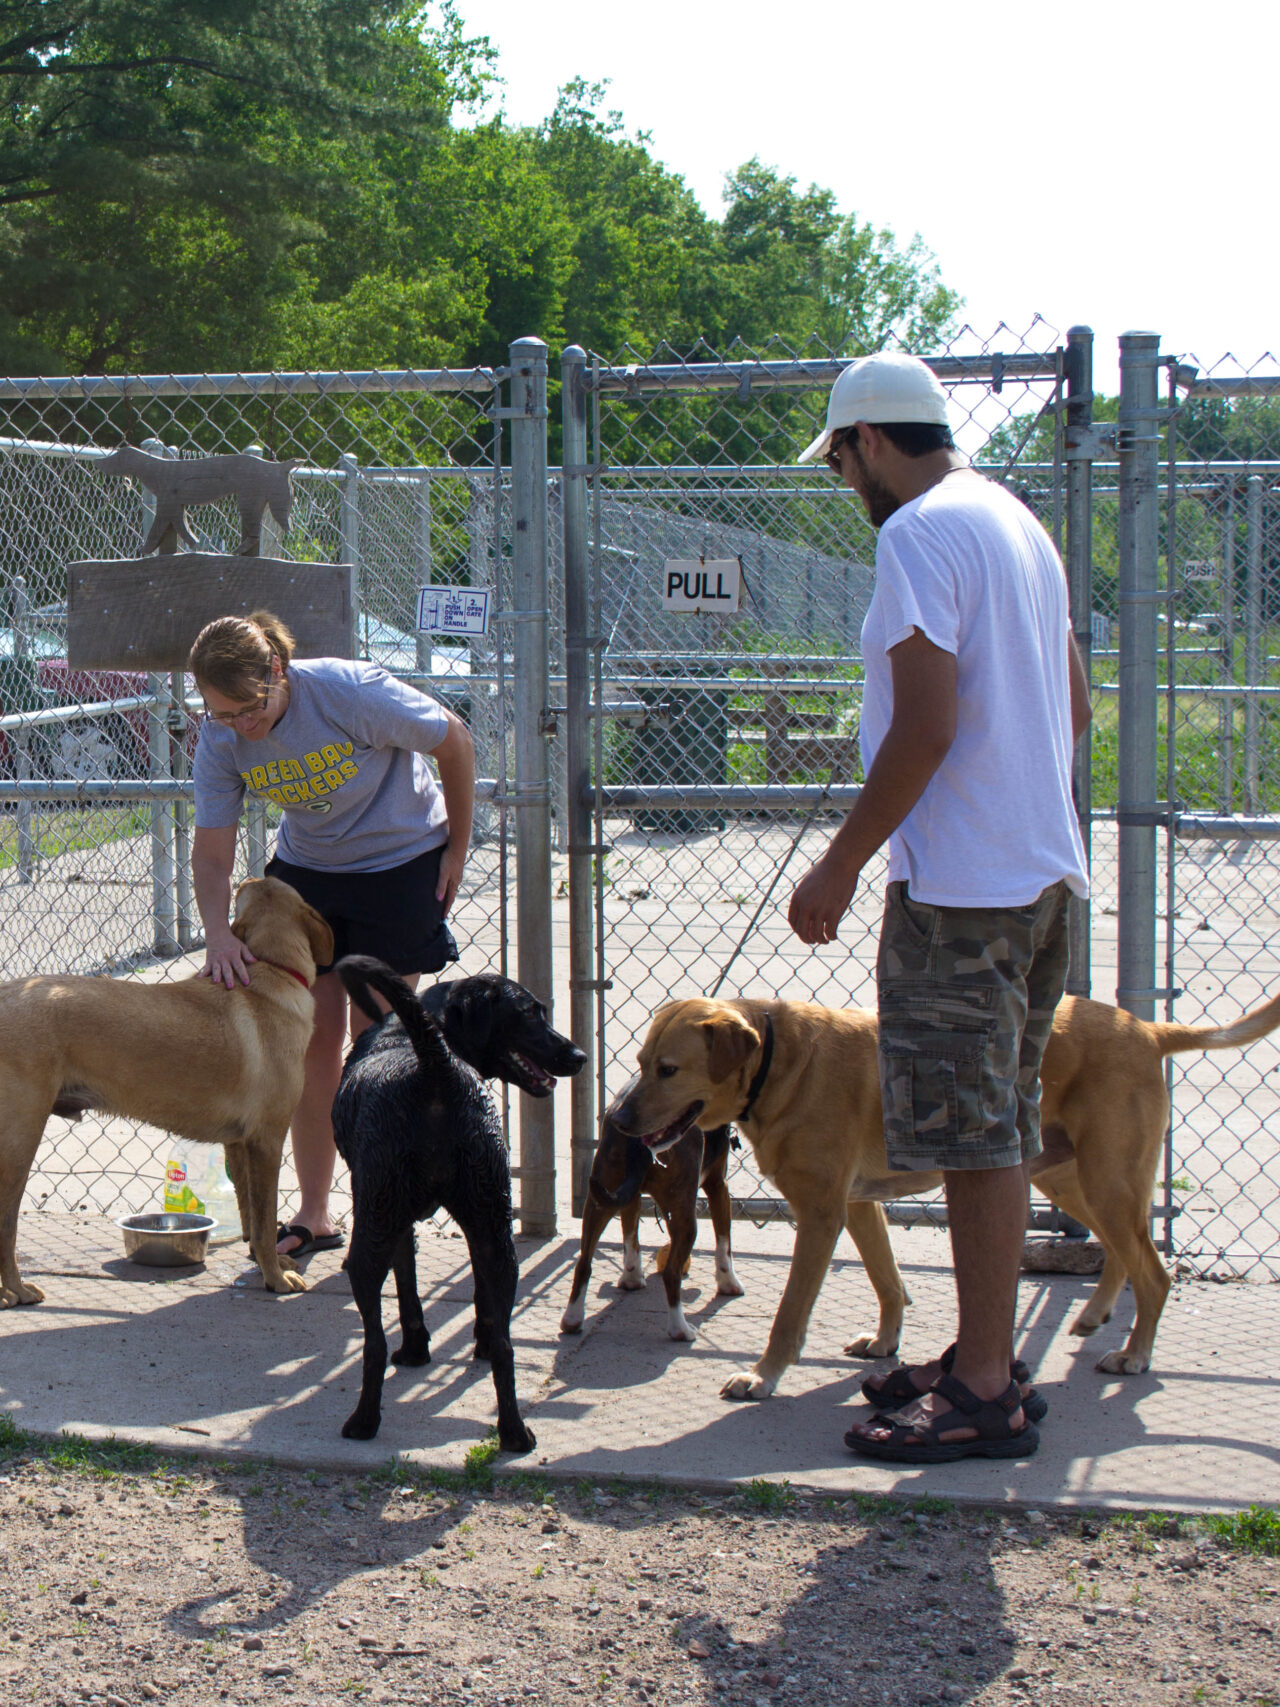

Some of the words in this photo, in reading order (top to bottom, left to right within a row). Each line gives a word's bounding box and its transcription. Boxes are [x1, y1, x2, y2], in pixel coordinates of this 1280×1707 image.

[1185, 565, 1216, 576] PUSH
[667, 572, 732, 599] PULL
[303, 741, 354, 774] BAY
